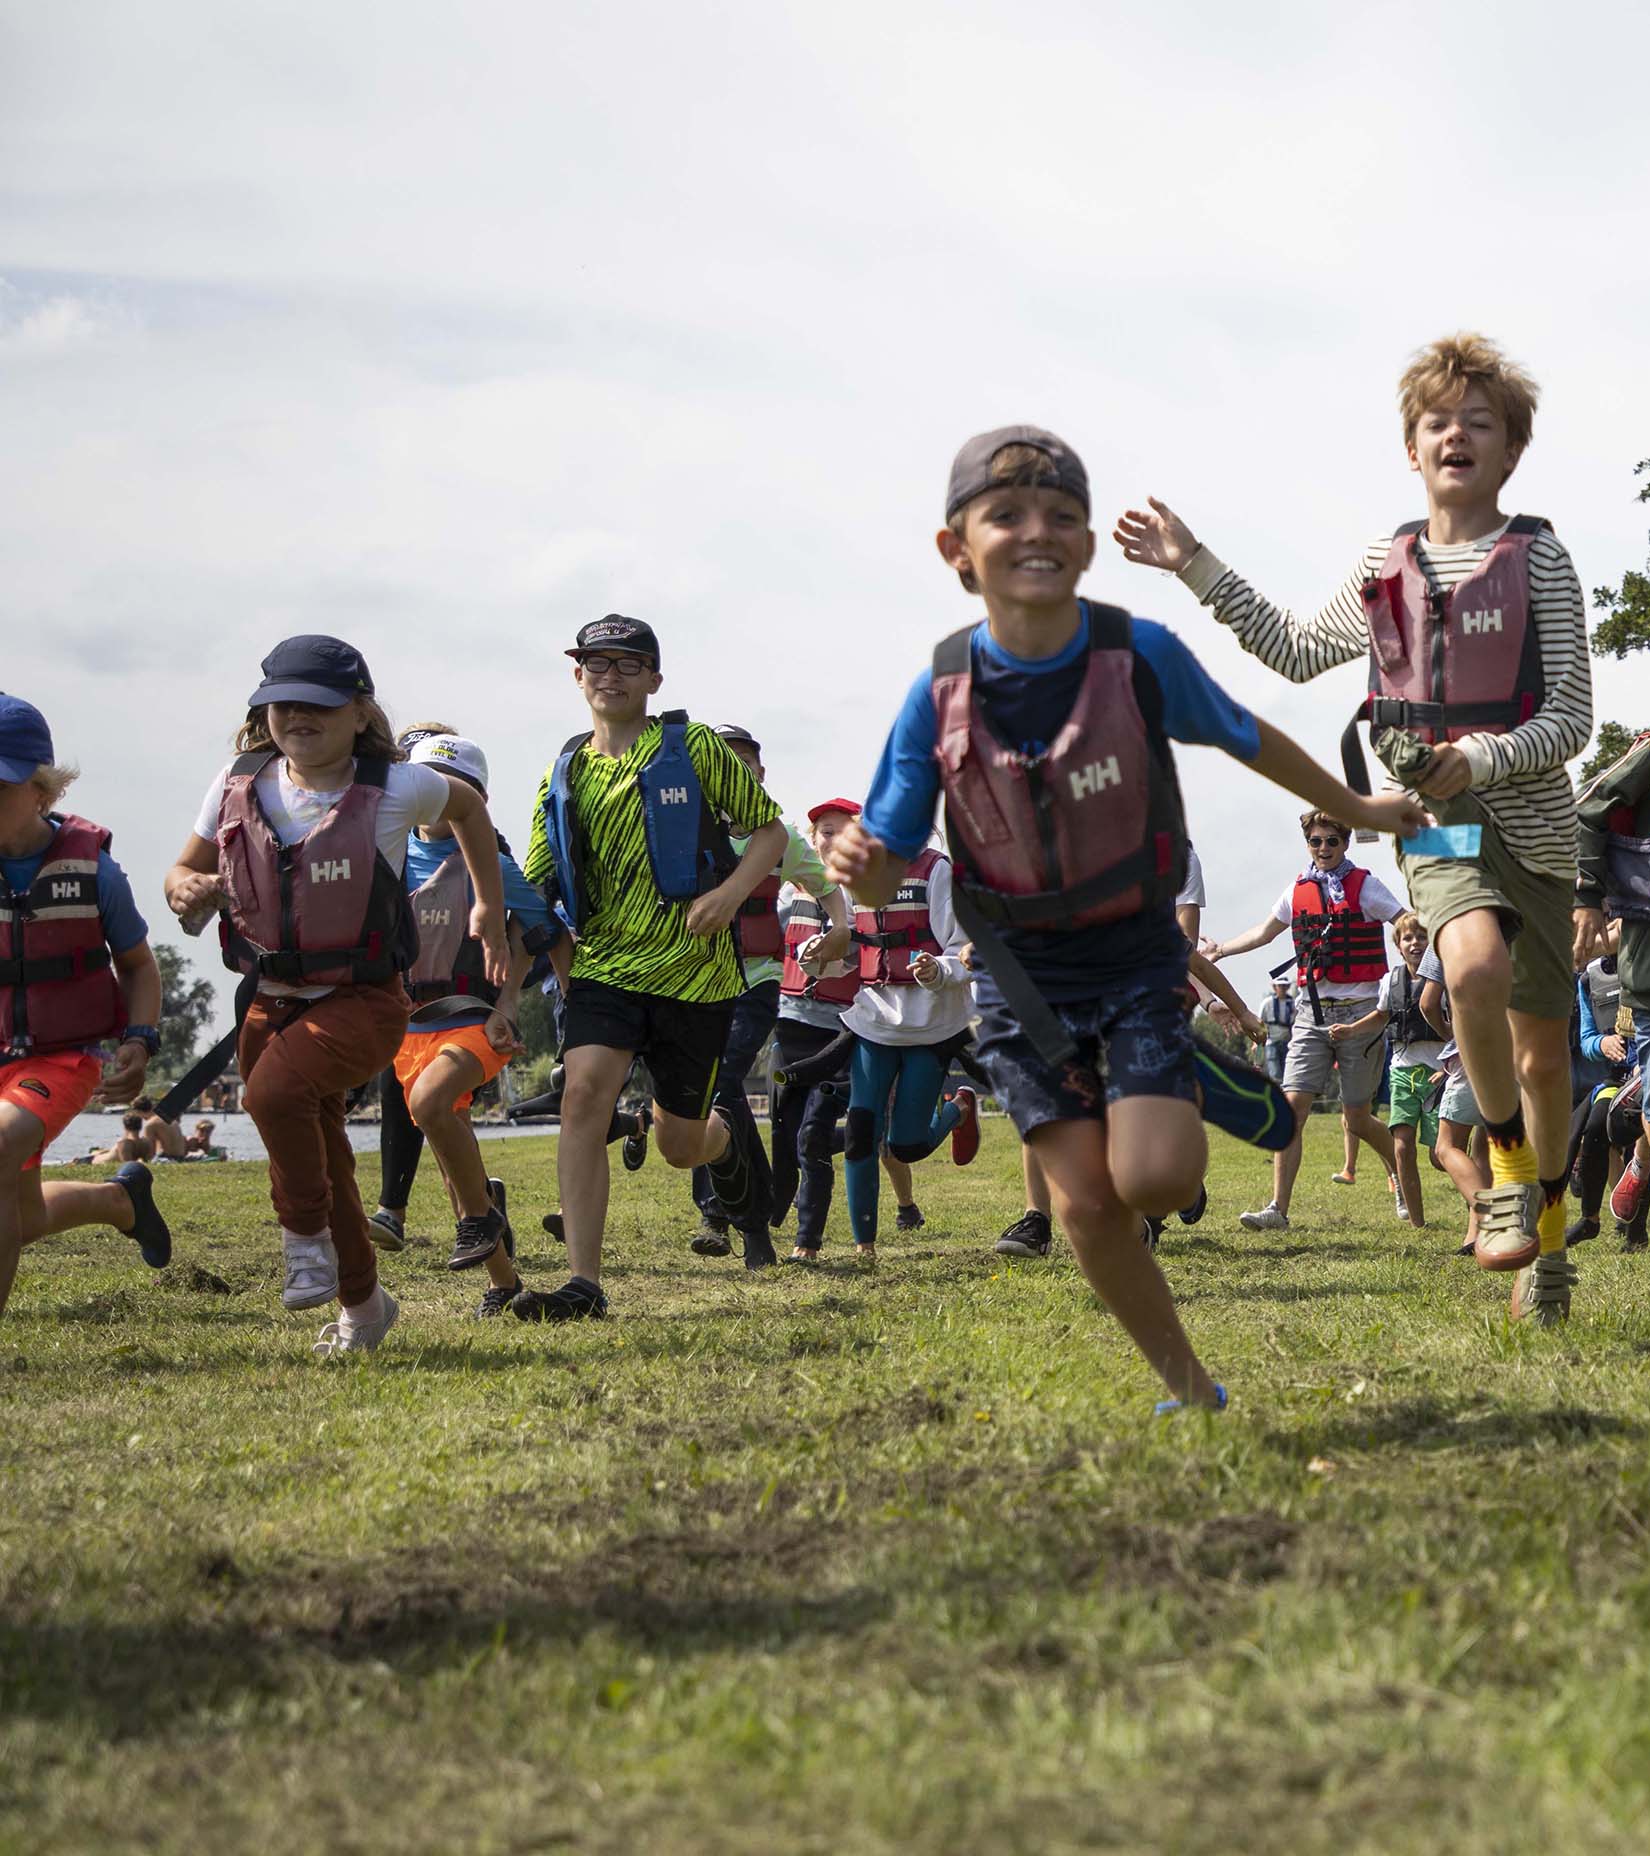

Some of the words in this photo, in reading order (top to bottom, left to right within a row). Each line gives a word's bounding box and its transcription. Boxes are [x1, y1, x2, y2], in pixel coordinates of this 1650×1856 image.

[1462, 608, 1503, 635] HH
[1069, 755, 1122, 801] HH
[660, 787, 688, 805] HH
[310, 859, 351, 883] HH
[52, 881, 81, 899] HH
[897, 889, 913, 900] HH
[421, 909, 451, 925] HH
